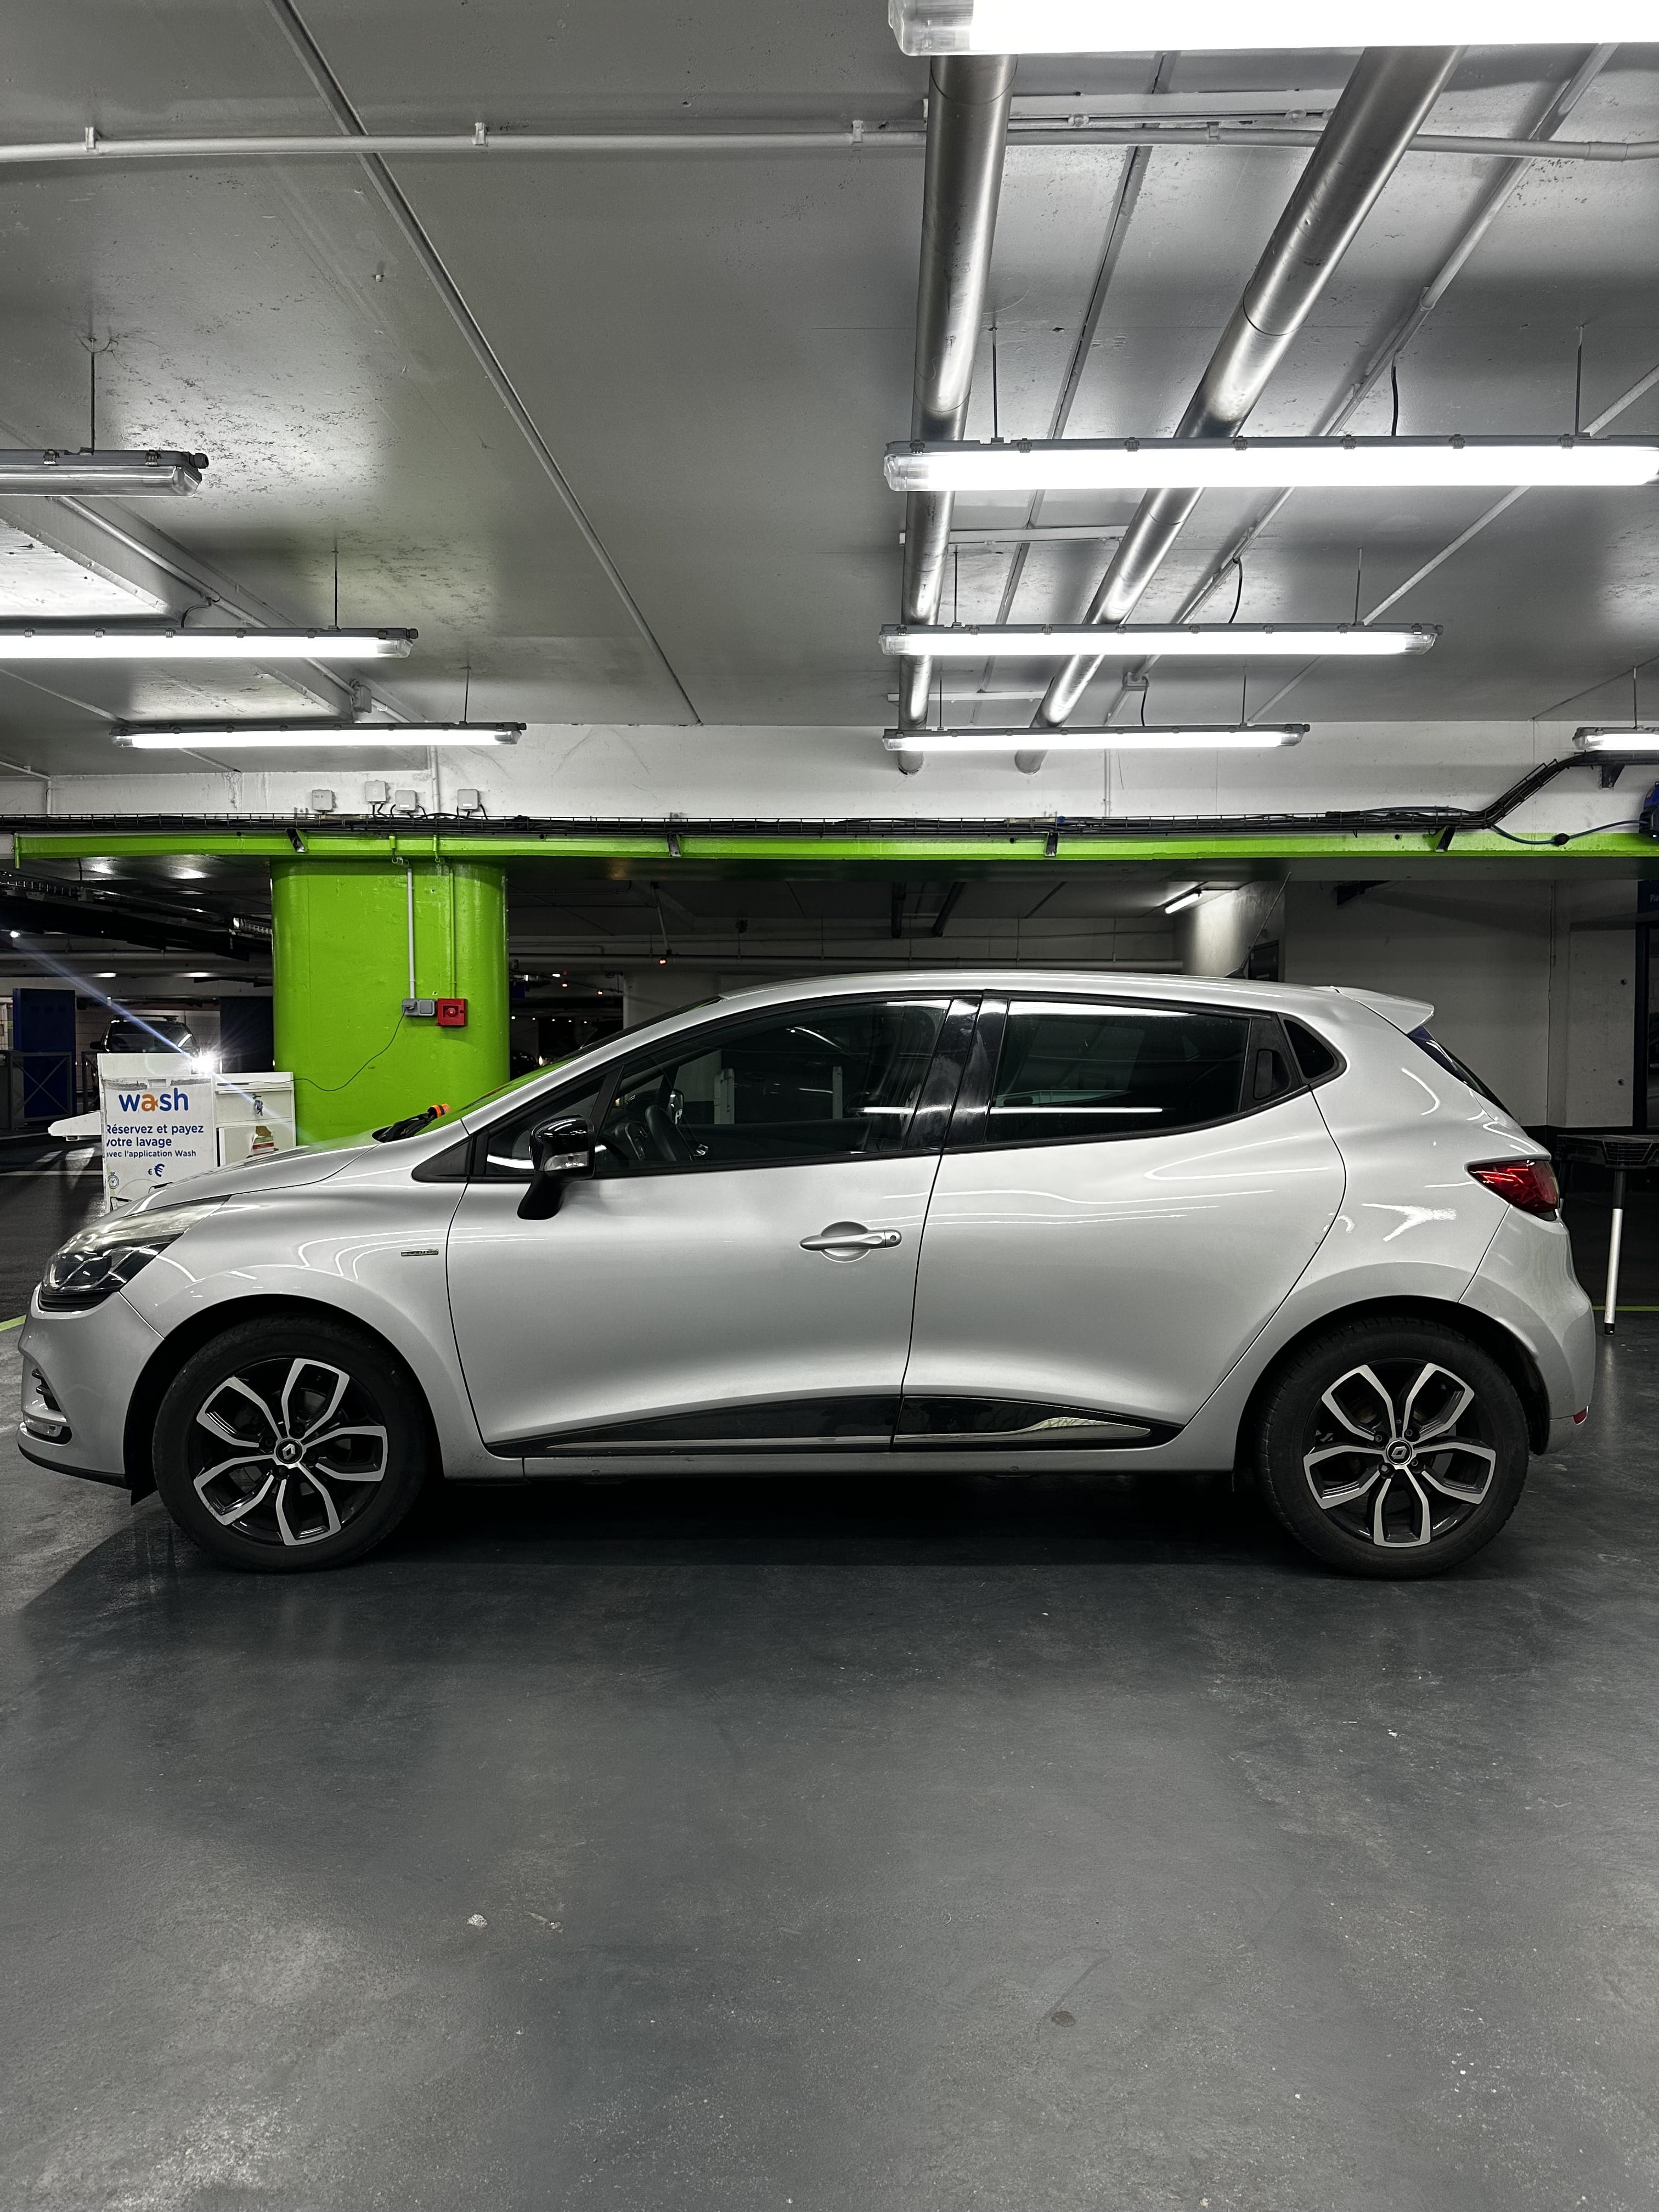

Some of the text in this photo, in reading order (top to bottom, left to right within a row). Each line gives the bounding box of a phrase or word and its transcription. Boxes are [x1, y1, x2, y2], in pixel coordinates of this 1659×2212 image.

[119, 1087, 189, 1112] wash
[107, 1124, 204, 1135] Réservez et payez
[137, 1137, 172, 1148] lavage
[125, 1150, 172, 1158] l'application
